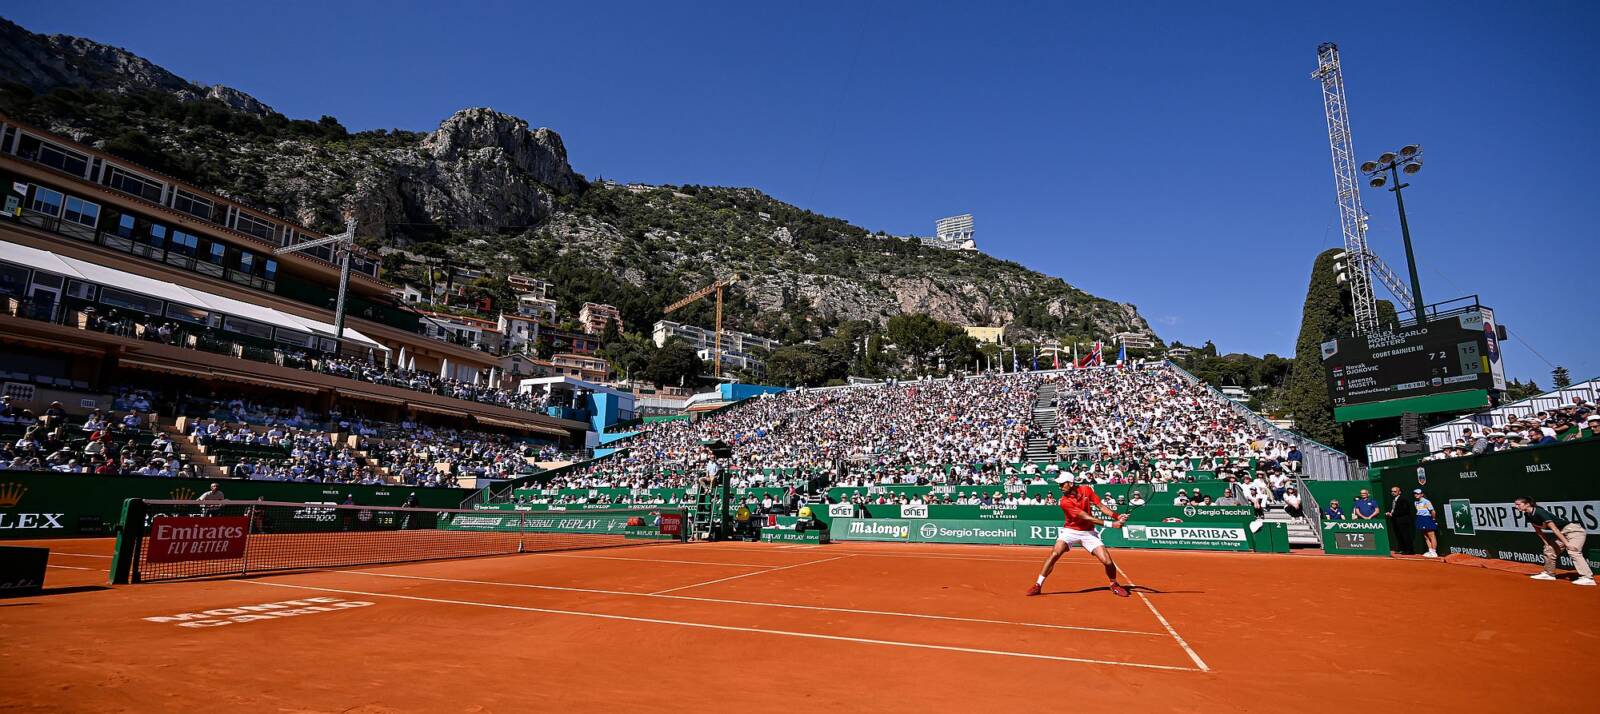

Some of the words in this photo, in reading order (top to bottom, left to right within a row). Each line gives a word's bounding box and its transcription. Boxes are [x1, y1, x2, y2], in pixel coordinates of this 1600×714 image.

[1367, 331, 1393, 340] ROLEX
[1367, 328, 1428, 344] MONTE-CARLO
[1368, 338, 1406, 349] MASTERS
[1372, 351, 1391, 359] COURT
[1391, 346, 1416, 356] RAINIER
[1462, 346, 1475, 354] 15
[1346, 365, 1379, 375] DJOKOVIC
[1442, 366, 1448, 374] 1
[1464, 361, 1478, 370] 15
[1348, 380, 1377, 389] MUSETTI
[1526, 463, 1551, 473] ROLEX
[1460, 471, 1478, 479] ROLEX
[1197, 508, 1221, 517] Sergio
[1221, 508, 1251, 516] Tacchini
[1475, 506, 1507, 527] BNP
[558, 520, 600, 529] REPLAY
[851, 521, 909, 538] Malongo
[157, 524, 243, 541] Emirates
[939, 527, 972, 538] Sergio
[972, 528, 1017, 537] Tacchini
[1150, 528, 1177, 538] BNP
[1180, 529, 1239, 539] PARIBAS
[1345, 533, 1365, 542] 175
[167, 541, 189, 555] FLY
[189, 540, 229, 554] BETTER
[1450, 546, 1462, 554] BNP
[1462, 547, 1488, 558] PARIBAS
[1498, 550, 1513, 560] BNP
[1514, 552, 1545, 564] PARIBAS
[141, 596, 346, 623] MONTE
[174, 601, 377, 628] CARLO
